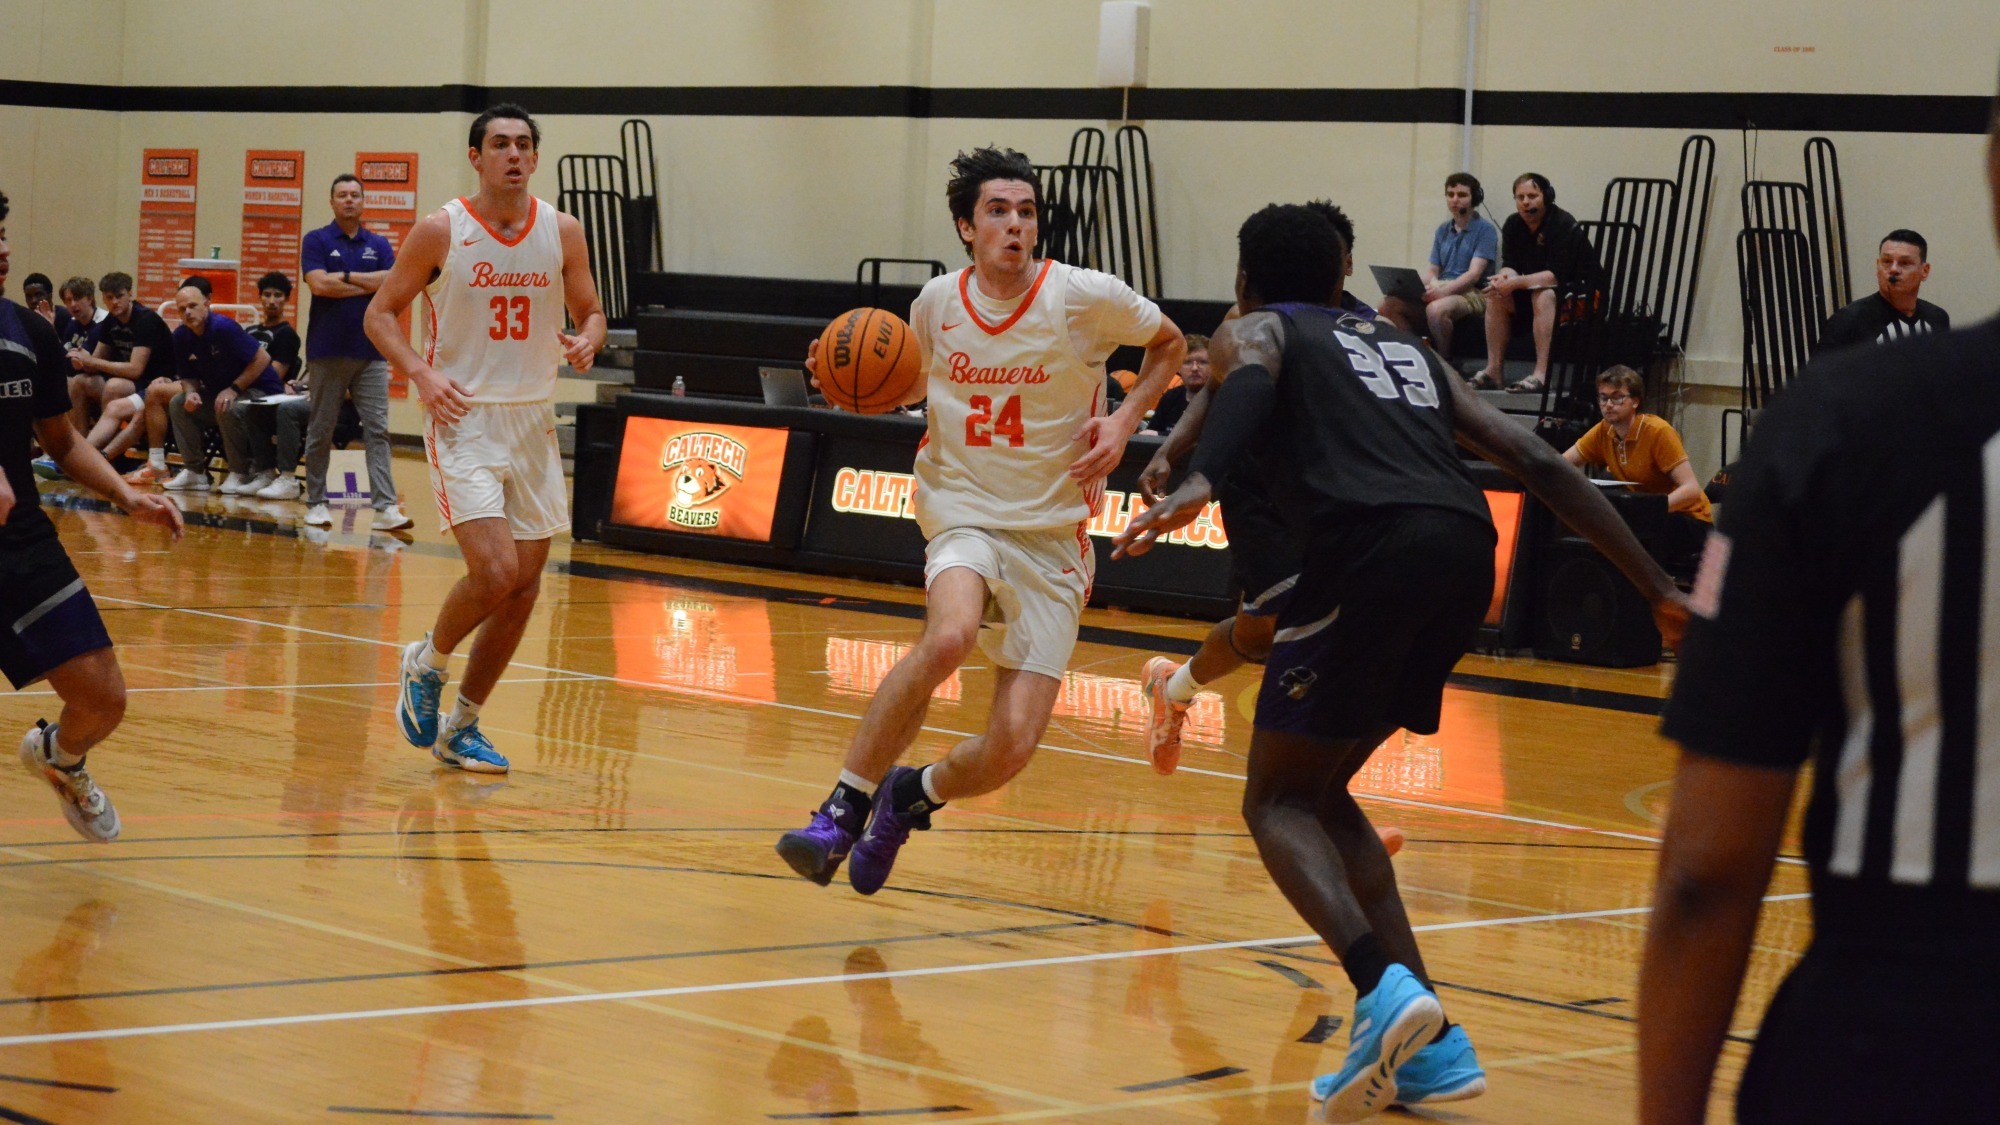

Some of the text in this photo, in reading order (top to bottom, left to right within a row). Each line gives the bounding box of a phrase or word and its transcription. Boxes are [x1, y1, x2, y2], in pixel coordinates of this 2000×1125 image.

[148, 158, 190, 176] CALTECH
[251, 159, 295, 178] CALTECH
[361, 162, 409, 181] CALTECH
[159, 188, 190, 199] BASKETBALL
[268, 191, 299, 202] BASKETBALL
[364, 194, 406, 206] OLLEYBALL
[469, 261, 551, 288] Beavers
[489, 295, 531, 341] 33
[949, 351, 1051, 385] Beavers
[1332, 330, 1440, 410] 33
[965, 394, 1025, 447] 24
[663, 432, 746, 480] CALTECH
[668, 506, 720, 527] BEAVERS
